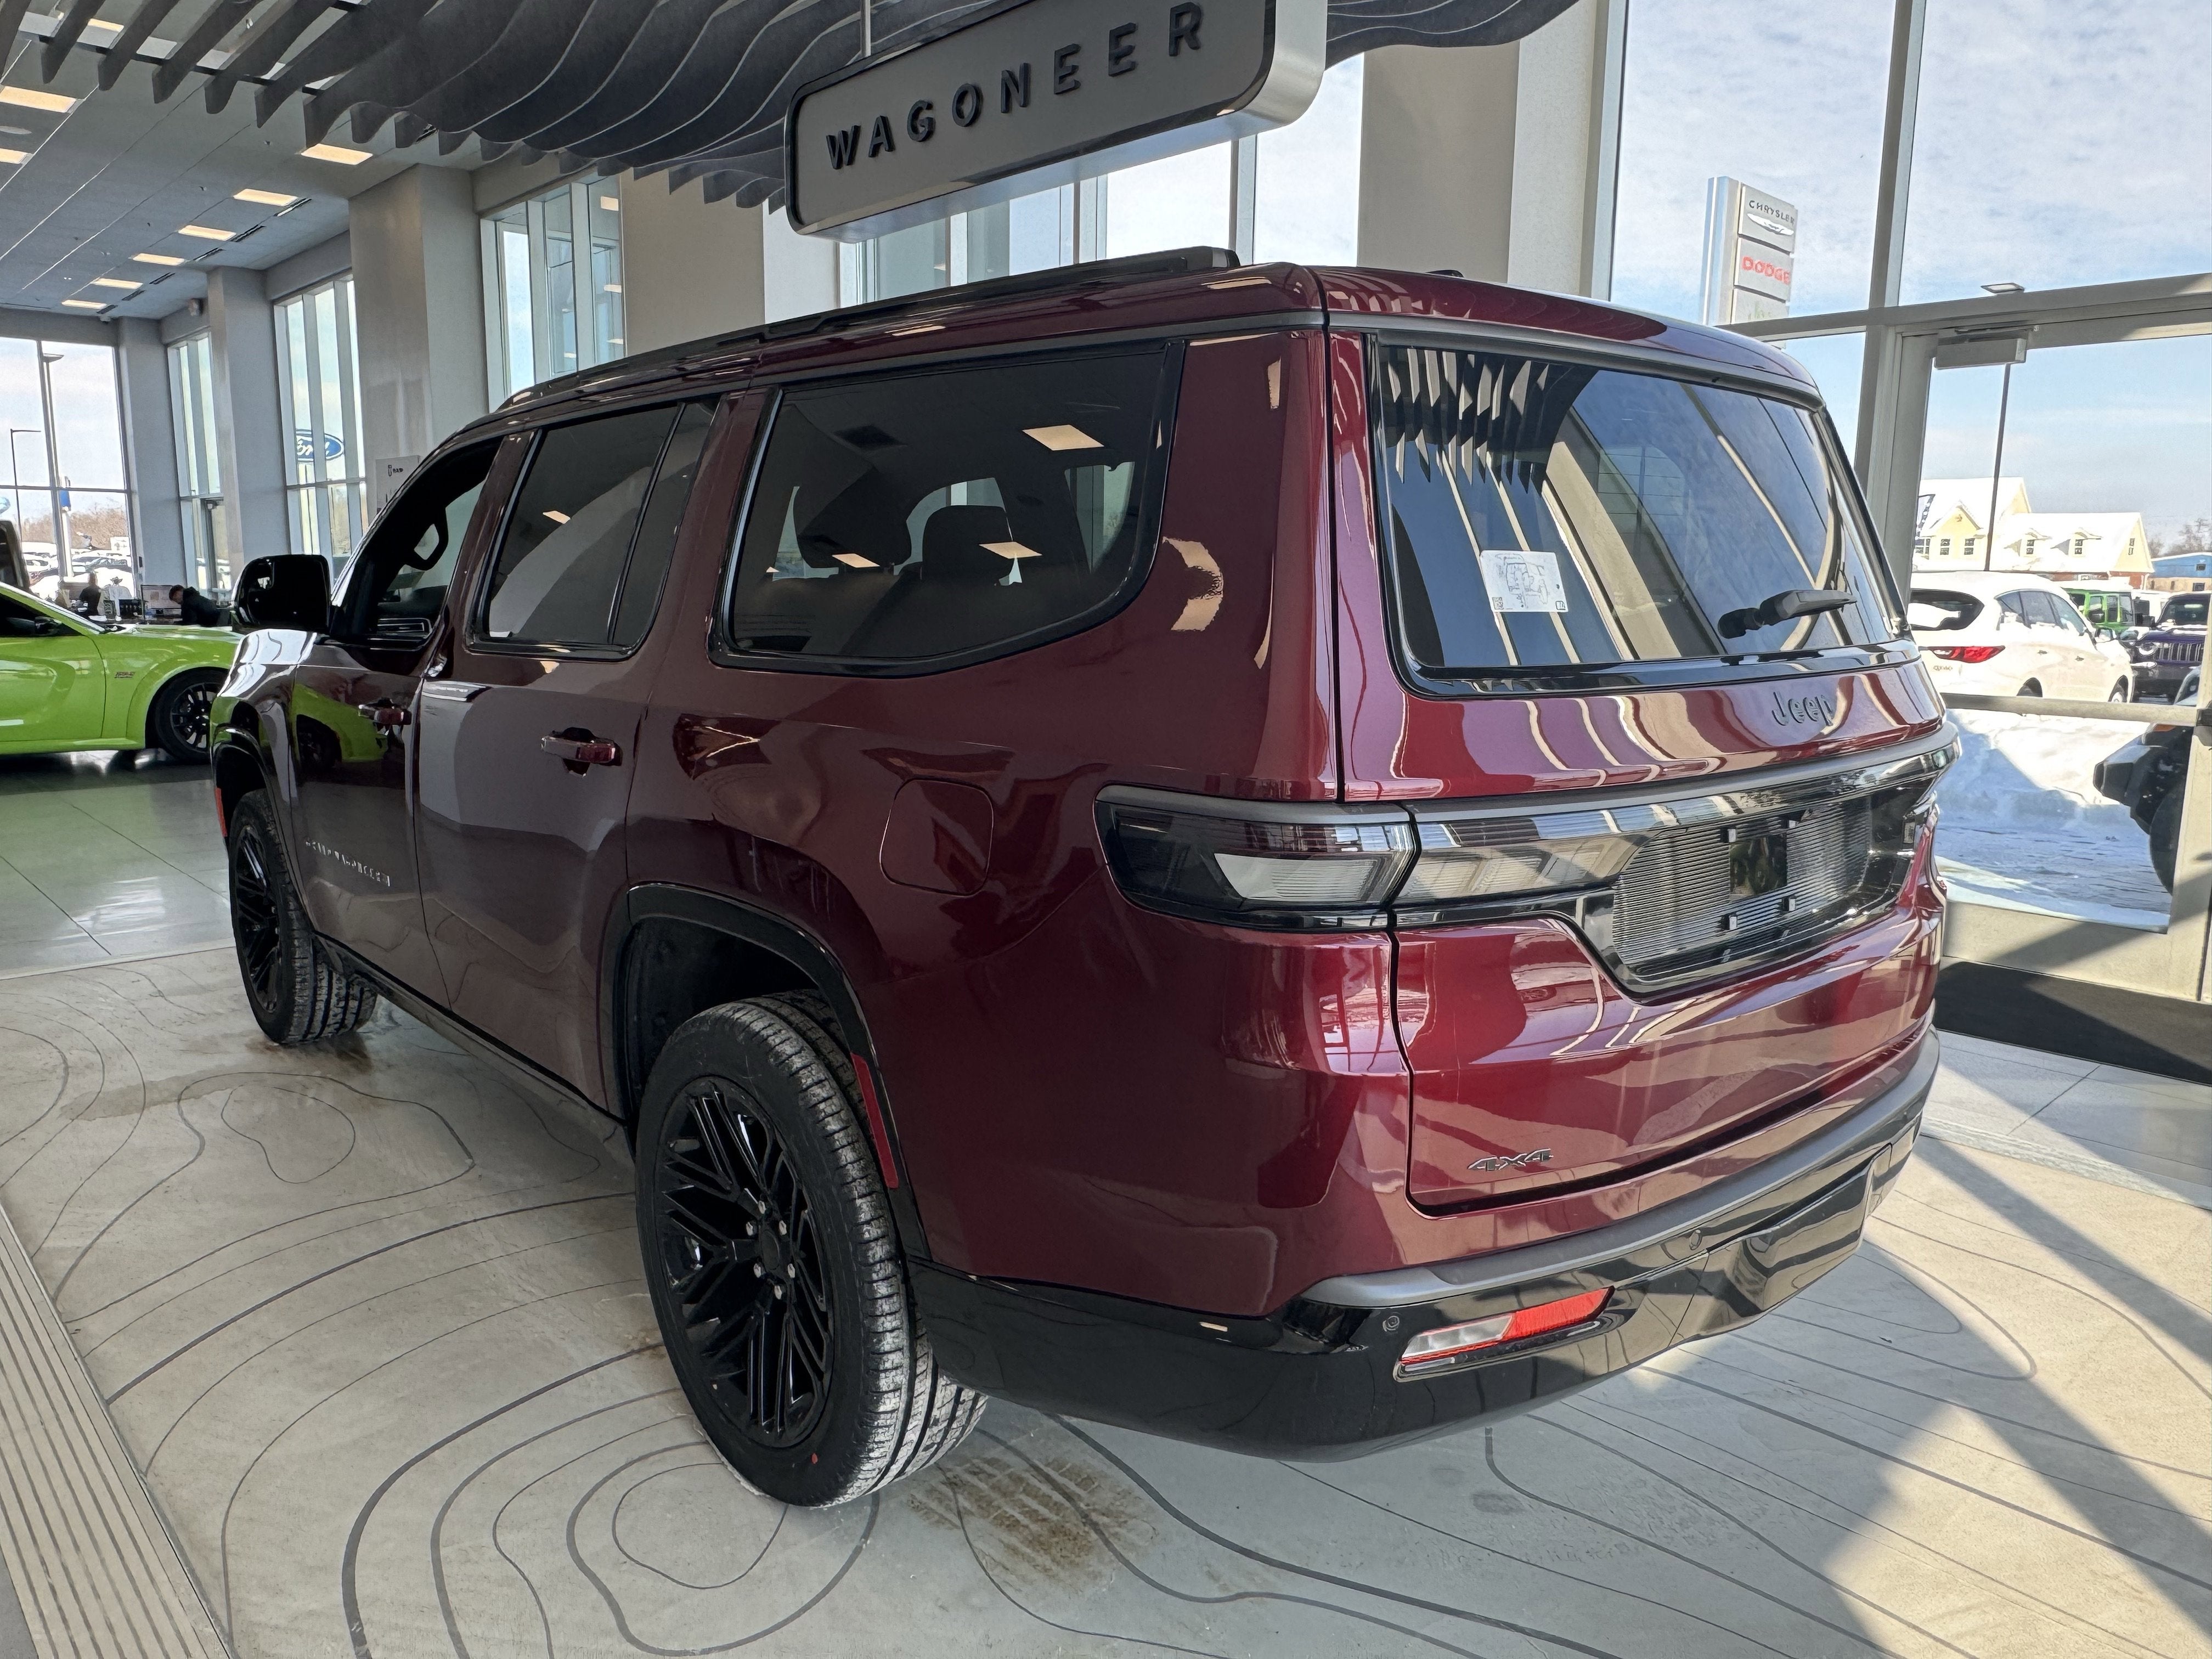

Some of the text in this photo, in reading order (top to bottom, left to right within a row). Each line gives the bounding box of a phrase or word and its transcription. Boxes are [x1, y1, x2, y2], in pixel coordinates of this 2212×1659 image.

[826, 1, 1202, 170] WAGONEER
[1741, 256, 1791, 285] DODGE
[1771, 691, 1835, 726] Jeep
